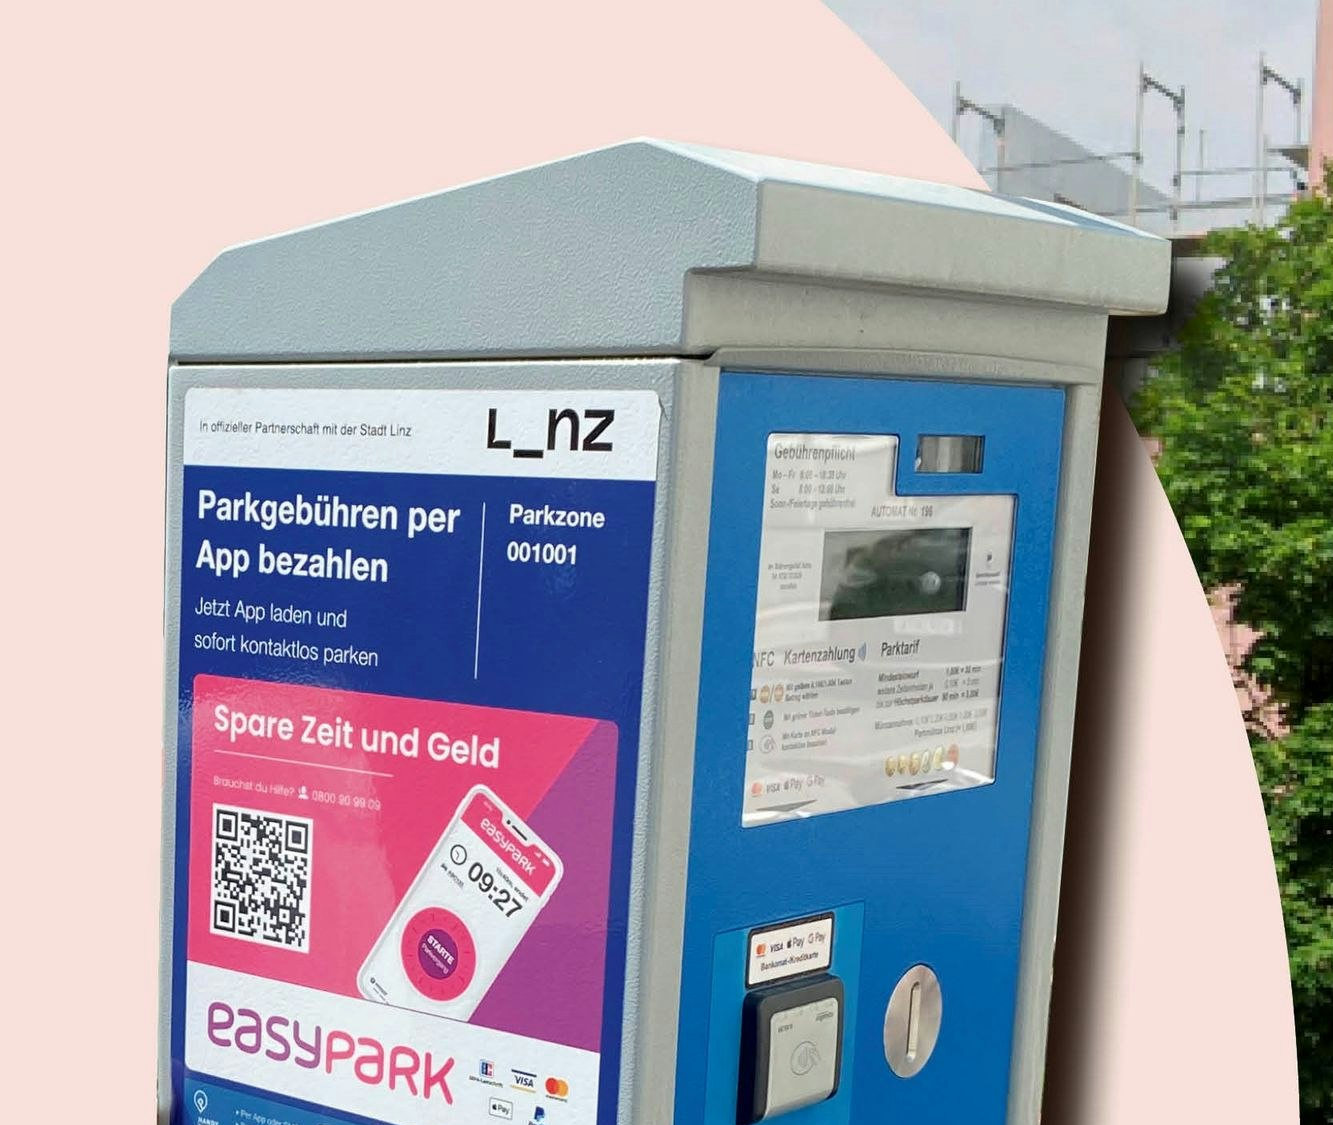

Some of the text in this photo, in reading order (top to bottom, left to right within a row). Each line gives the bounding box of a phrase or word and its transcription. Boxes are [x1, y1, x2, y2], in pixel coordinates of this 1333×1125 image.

[211, 421, 252, 435] offizieller
[255, 422, 319, 436] Partnerschaft
[322, 424, 338, 436] mit
[340, 424, 357, 436] der
[360, 424, 387, 437] Stadt
[390, 425, 412, 438] Linz
[198, 489, 461, 538] Parkgebühren per
[509, 503, 606, 529] Parkzone
[196, 539, 389, 582] App bezahlen
[507, 541, 577, 566] 001001
[195, 597, 348, 629] Jetzt App laden und
[194, 632, 379, 669] sofort kontaktlos parken
[784, 645, 856, 666] Kartenzahlung
[880, 639, 920, 656] Parktarif
[213, 703, 500, 769] Spare Zeit und Geld
[213, 776, 253, 791] Brauchst
[255, 783, 268, 793] du
[269, 786, 295, 797] Hilfe?
[468, 862, 523, 917] 09:27
[427, 935, 455, 965] STARTE
[513, 1074, 535, 1088] VISA
[253, 1113, 266, 1125] App
